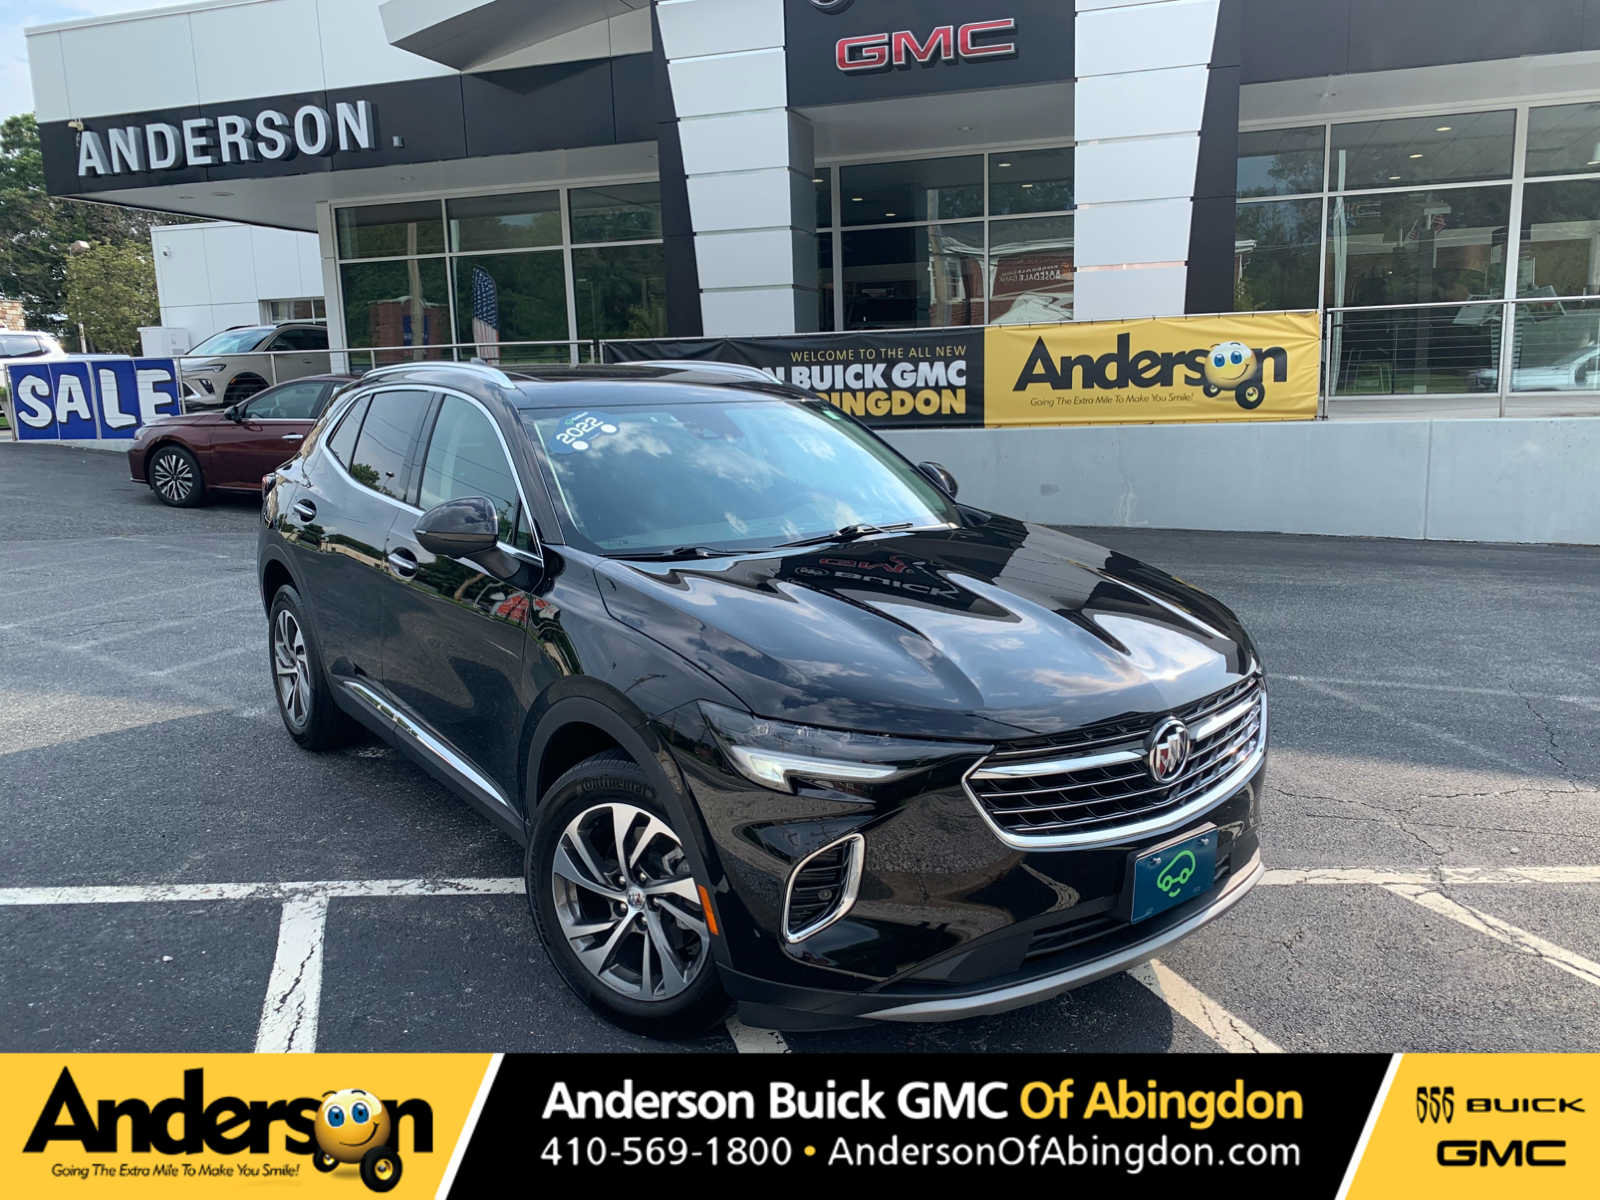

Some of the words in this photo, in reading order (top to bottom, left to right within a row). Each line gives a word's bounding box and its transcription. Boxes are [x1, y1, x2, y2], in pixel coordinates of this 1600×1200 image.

[836, 18, 1015, 71] GMC
[78, 100, 376, 177] ANDERSON
[790, 349, 854, 362] WELCOME
[860, 348, 876, 360] TO
[880, 348, 904, 359] THE
[908, 347, 931, 358] ALL
[936, 345, 967, 357] NEW
[791, 363, 889, 391] BUICK
[891, 360, 967, 389] GMC
[18, 368, 173, 428] SALE
[816, 388, 967, 417] INGDON
[1030, 397, 1055, 408] Going
[1056, 396, 1072, 406] The
[1073, 395, 1094, 405] Extra
[1095, 394, 1113, 404] Mile
[1115, 394, 1125, 404] To
[1126, 394, 1150, 403] Make
[1151, 393, 1168, 402] You
[1168, 392, 1195, 402] Smile!
[556, 417, 604, 445] 2022
